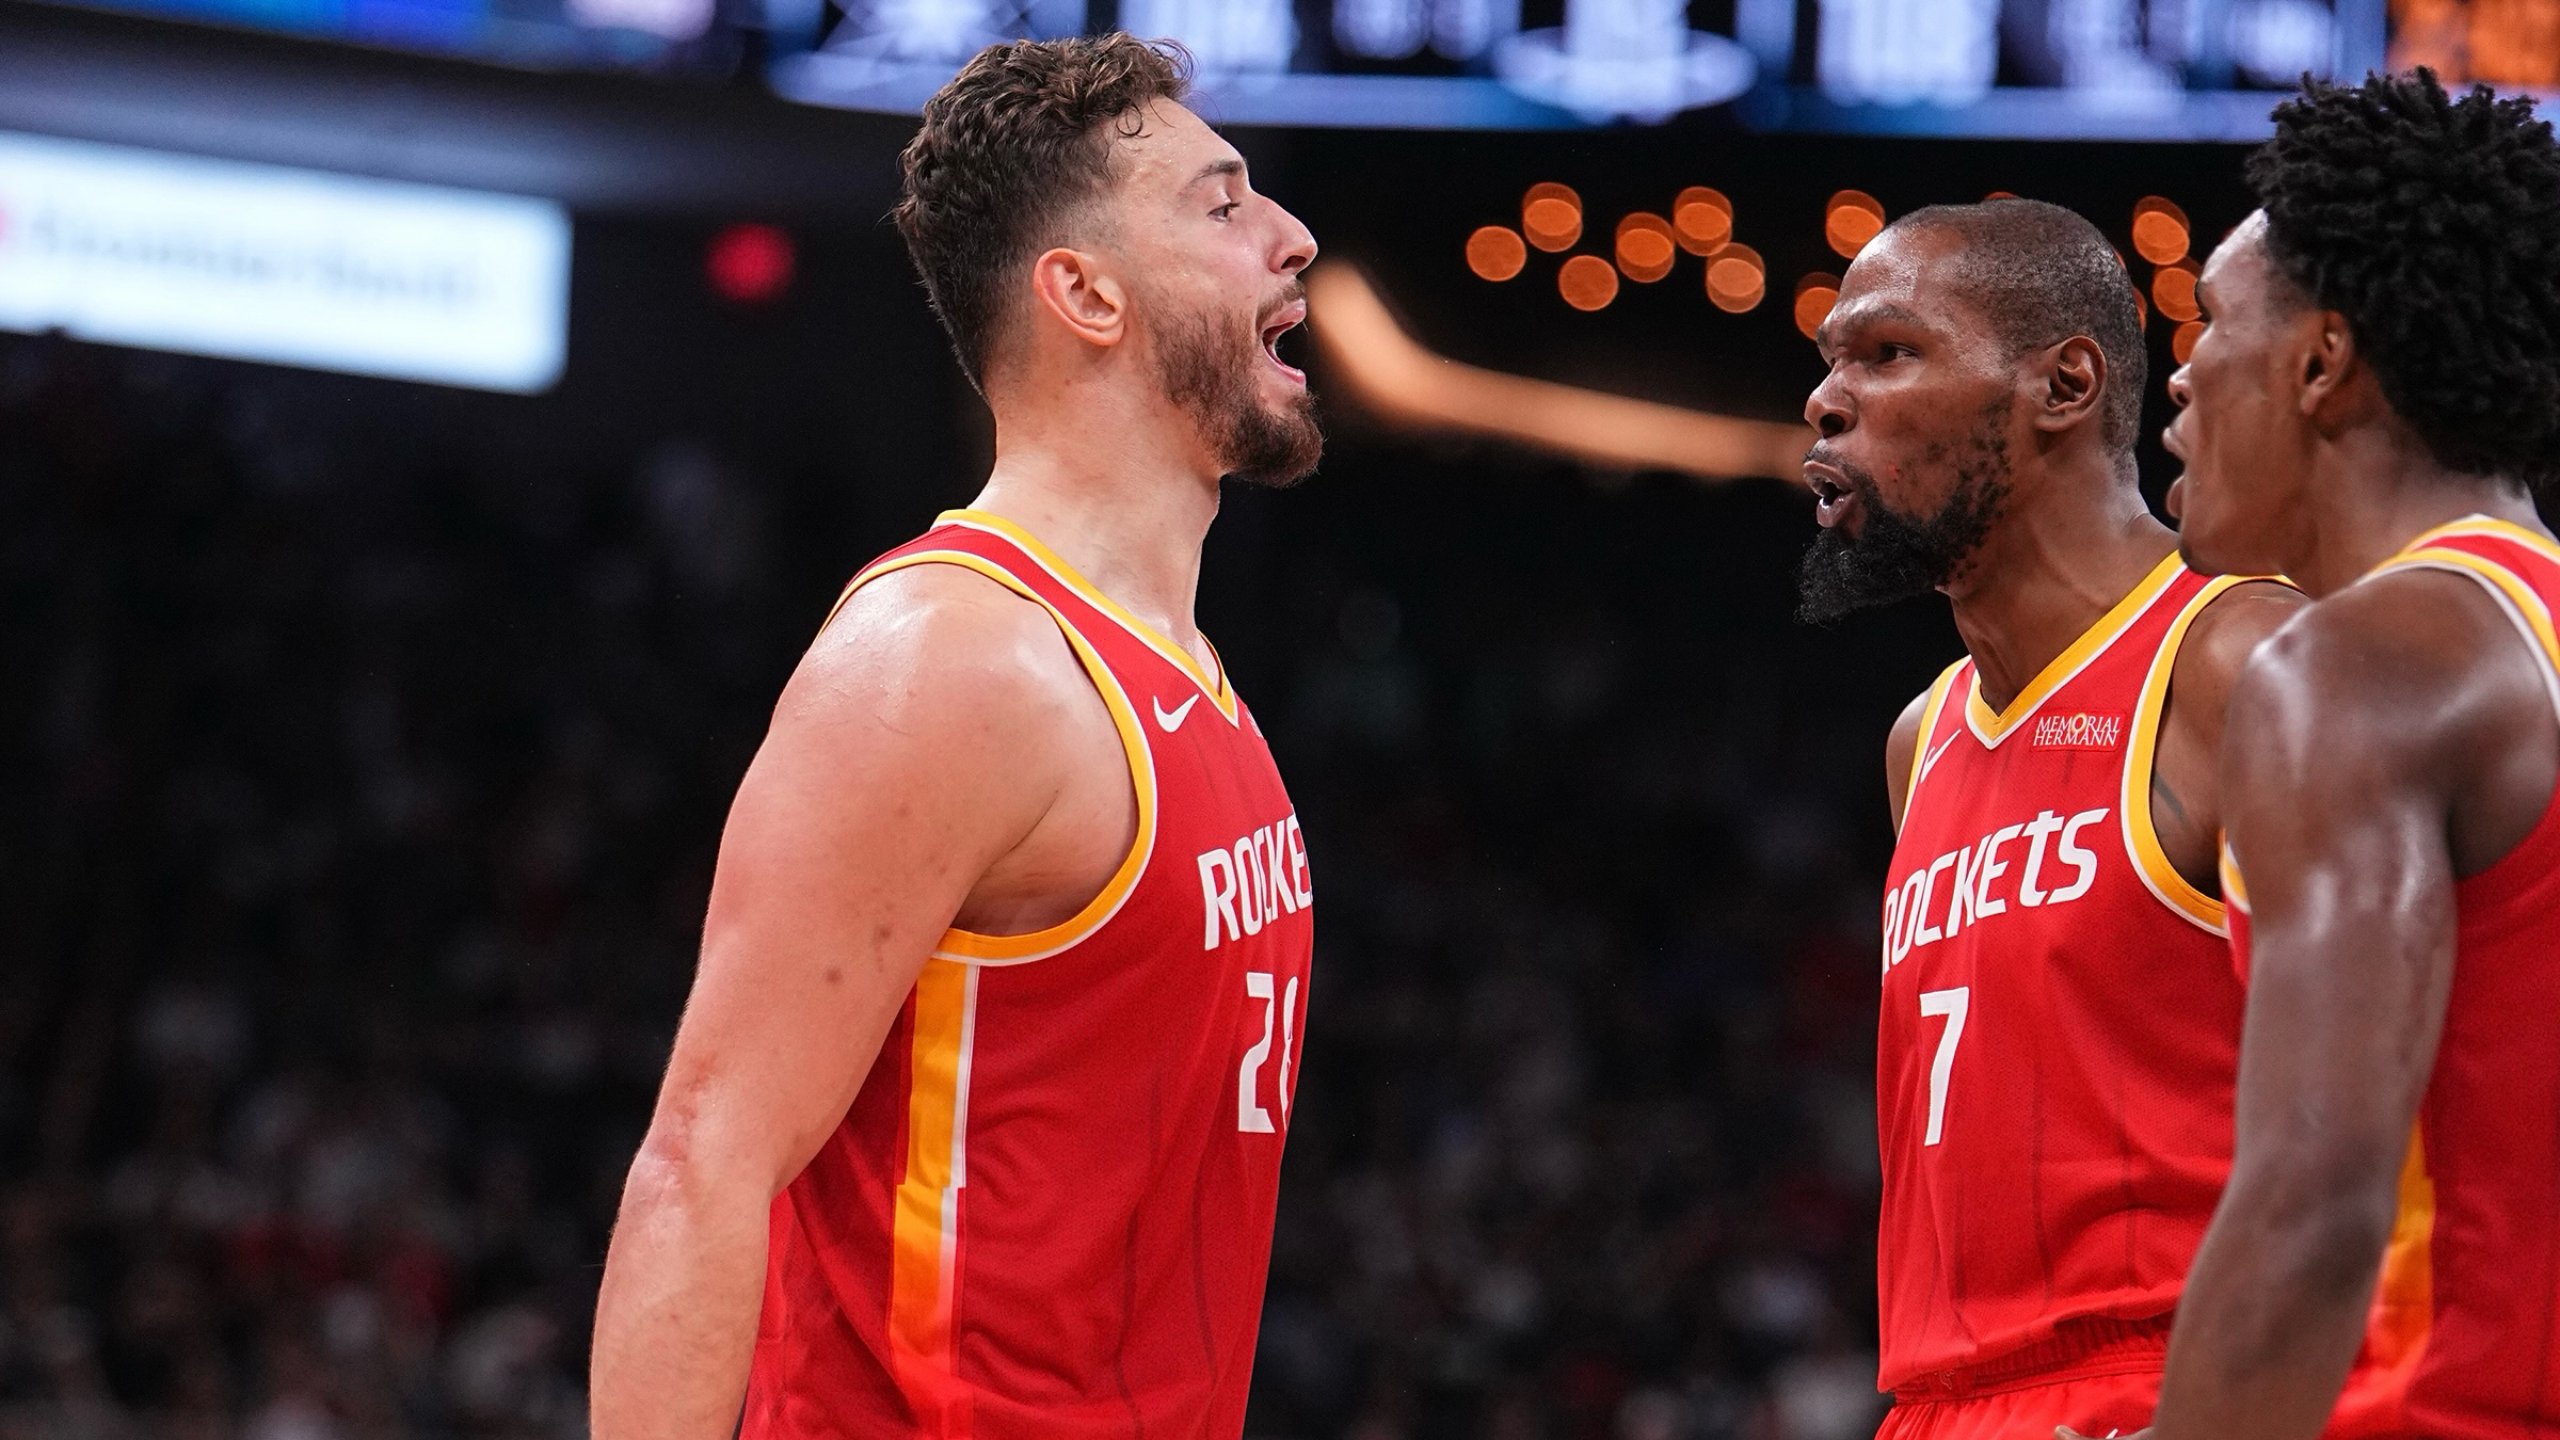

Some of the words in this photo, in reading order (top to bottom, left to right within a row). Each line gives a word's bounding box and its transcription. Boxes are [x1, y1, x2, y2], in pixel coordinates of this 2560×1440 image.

[2033, 730, 2117, 746] HERMANN
[2036, 712, 2120, 732] MEMORIAL
[1197, 804, 1313, 950] ROCKE
[1882, 808, 2110, 976] ROCKETS
[1920, 986, 1969, 1146] 7
